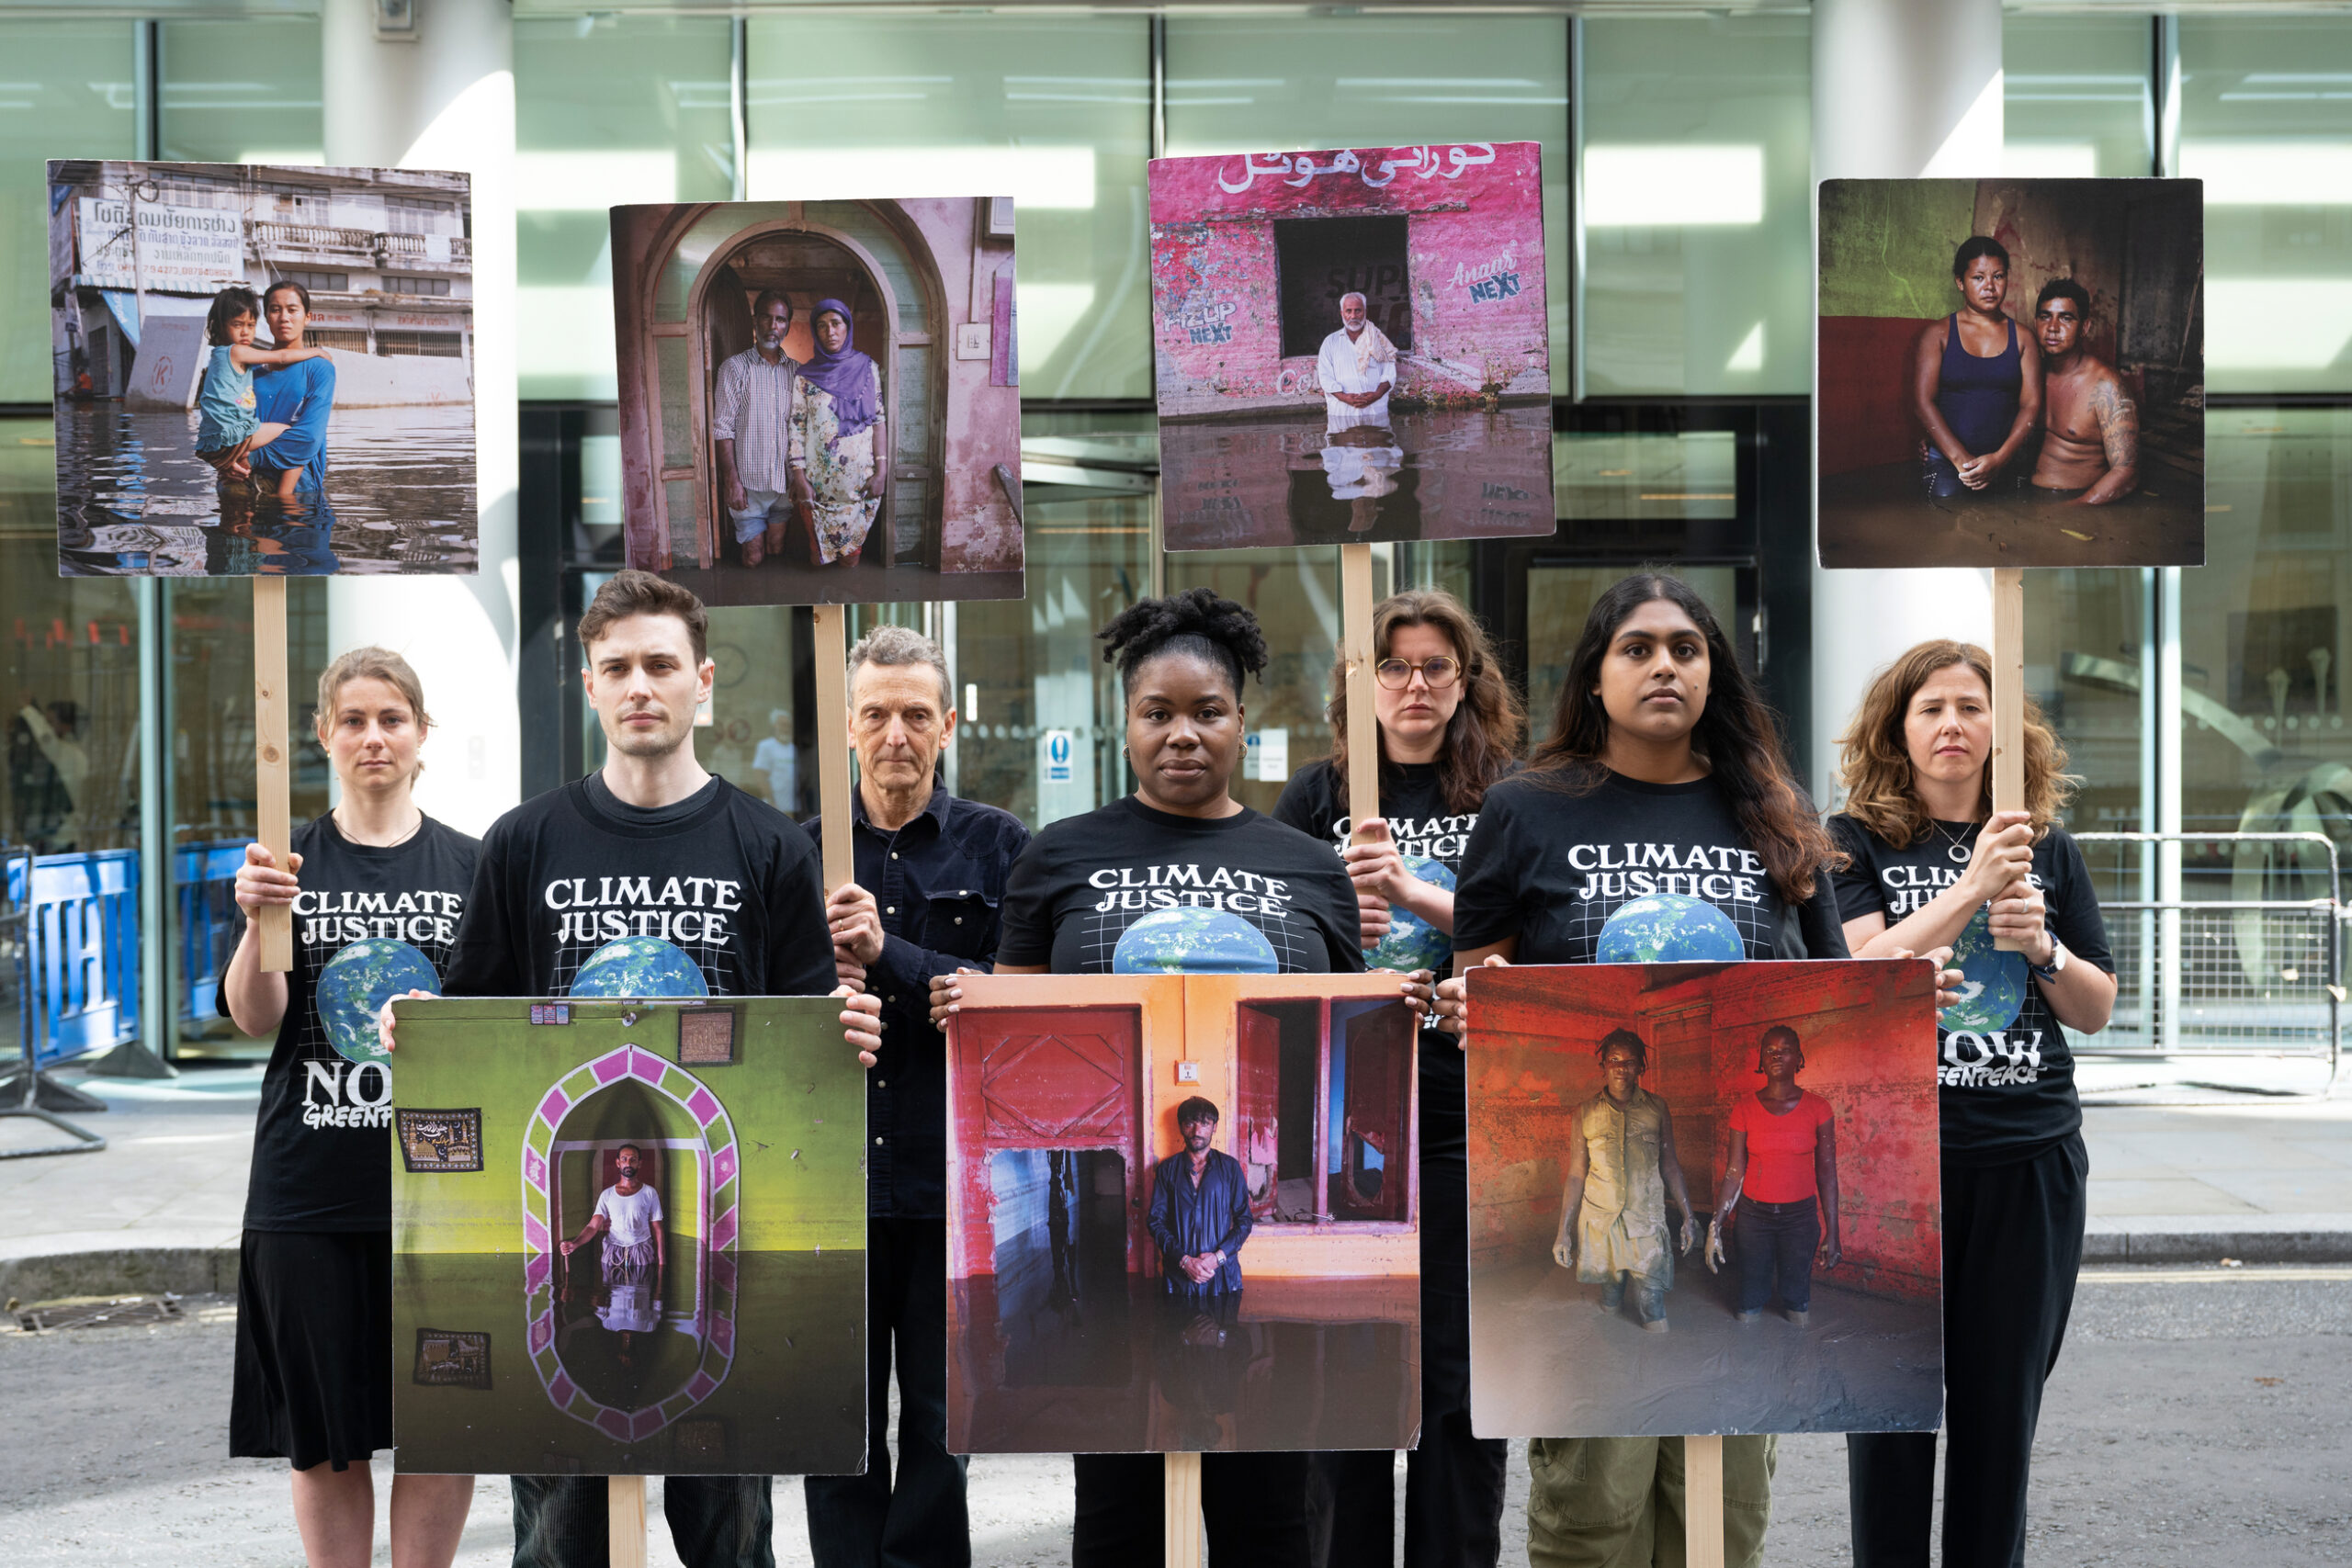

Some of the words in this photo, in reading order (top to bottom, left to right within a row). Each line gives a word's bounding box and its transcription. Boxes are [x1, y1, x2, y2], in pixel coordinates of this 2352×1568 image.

[1469, 271, 1521, 305] NEXT
[1188, 321, 1234, 347] NEXT
[1567, 843, 1768, 876] CLIMATE
[545, 876, 742, 912] CLIMATE
[1088, 863, 1293, 900] CLIMATE
[1578, 871, 1761, 903] JUSTICE
[291, 890, 463, 919] CLIMATE
[1095, 888, 1288, 918] JUSTICE
[301, 916, 456, 945] JUSTICE
[558, 909, 729, 945] JUSTICE
[1943, 1030, 2042, 1067] OW
[301, 1060, 392, 1107] NO
